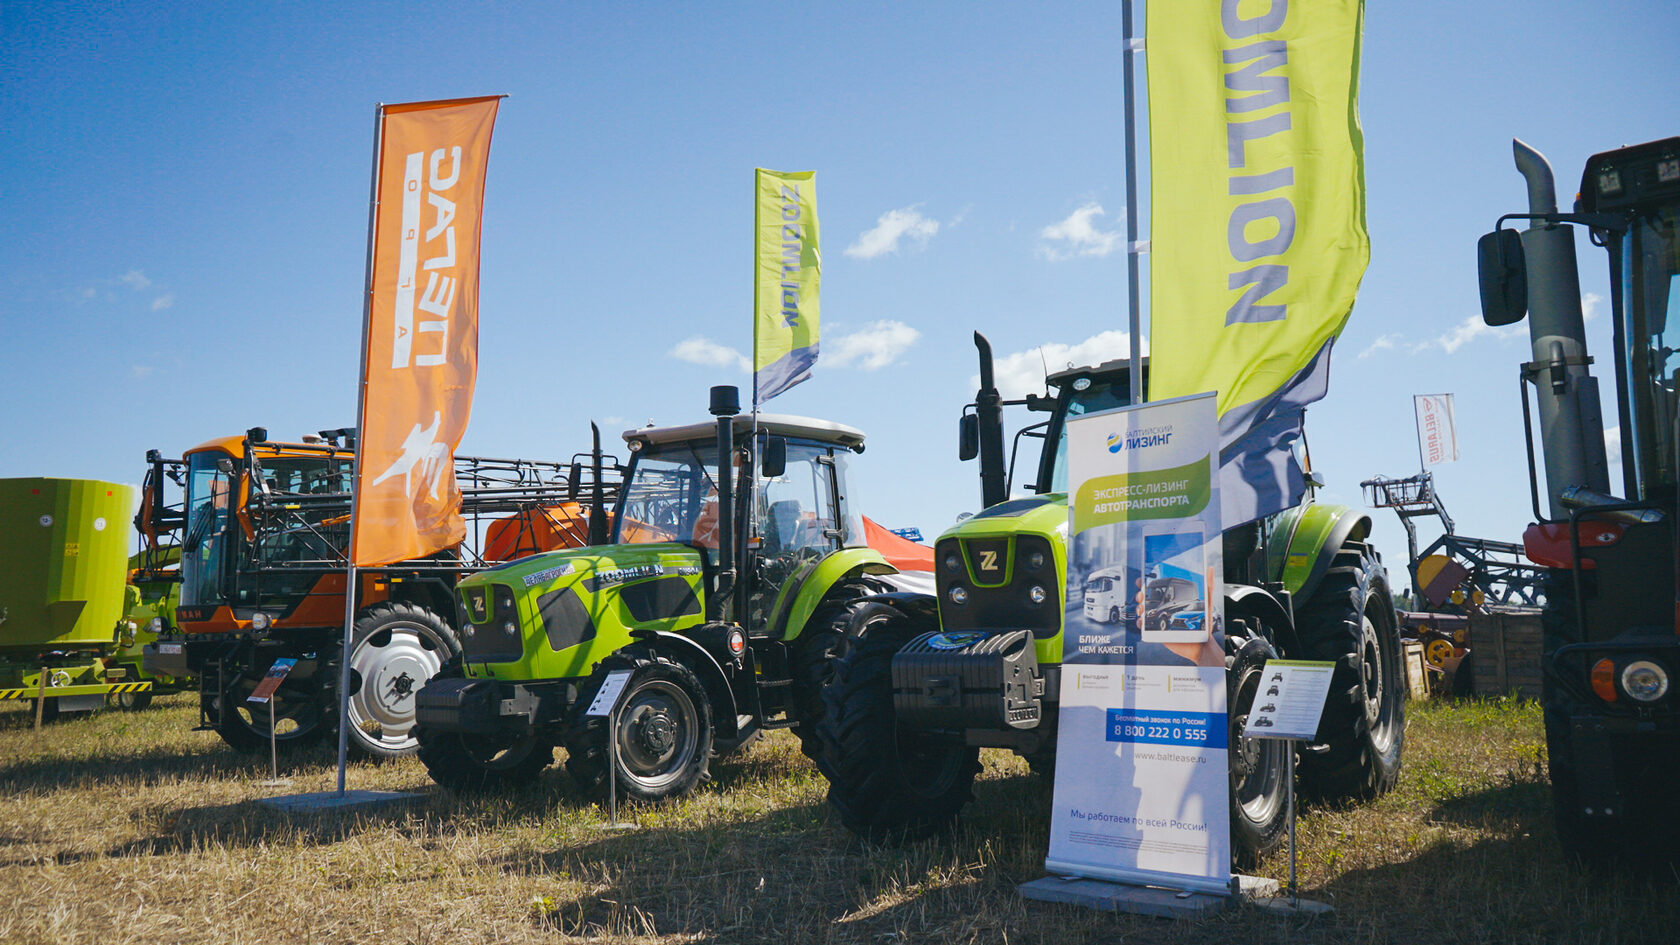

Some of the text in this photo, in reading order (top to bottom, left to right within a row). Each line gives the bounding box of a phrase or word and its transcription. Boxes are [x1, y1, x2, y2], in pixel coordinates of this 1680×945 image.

[781, 184, 801, 329] ZOOMLION
[1125, 433, 1172, 450] ЛИЗИНГ
[1093, 480, 1189, 500] ЭКСПРЕСС-ЛИЗИНГ
[1092, 495, 1190, 514] АВТОТРАНСПОРТА
[1079, 635, 1111, 644] БЛИЖЕ
[1078, 645, 1134, 655] ЧЕМ КАЖЕТСЯ
[1182, 717, 1206, 725] России!
[1114, 725, 1207, 741] 8 800 222 0 555
[1135, 752, 1207, 764] www.baltlease.ru
[1070, 809, 1207, 832] Мы работаем по всей России!
